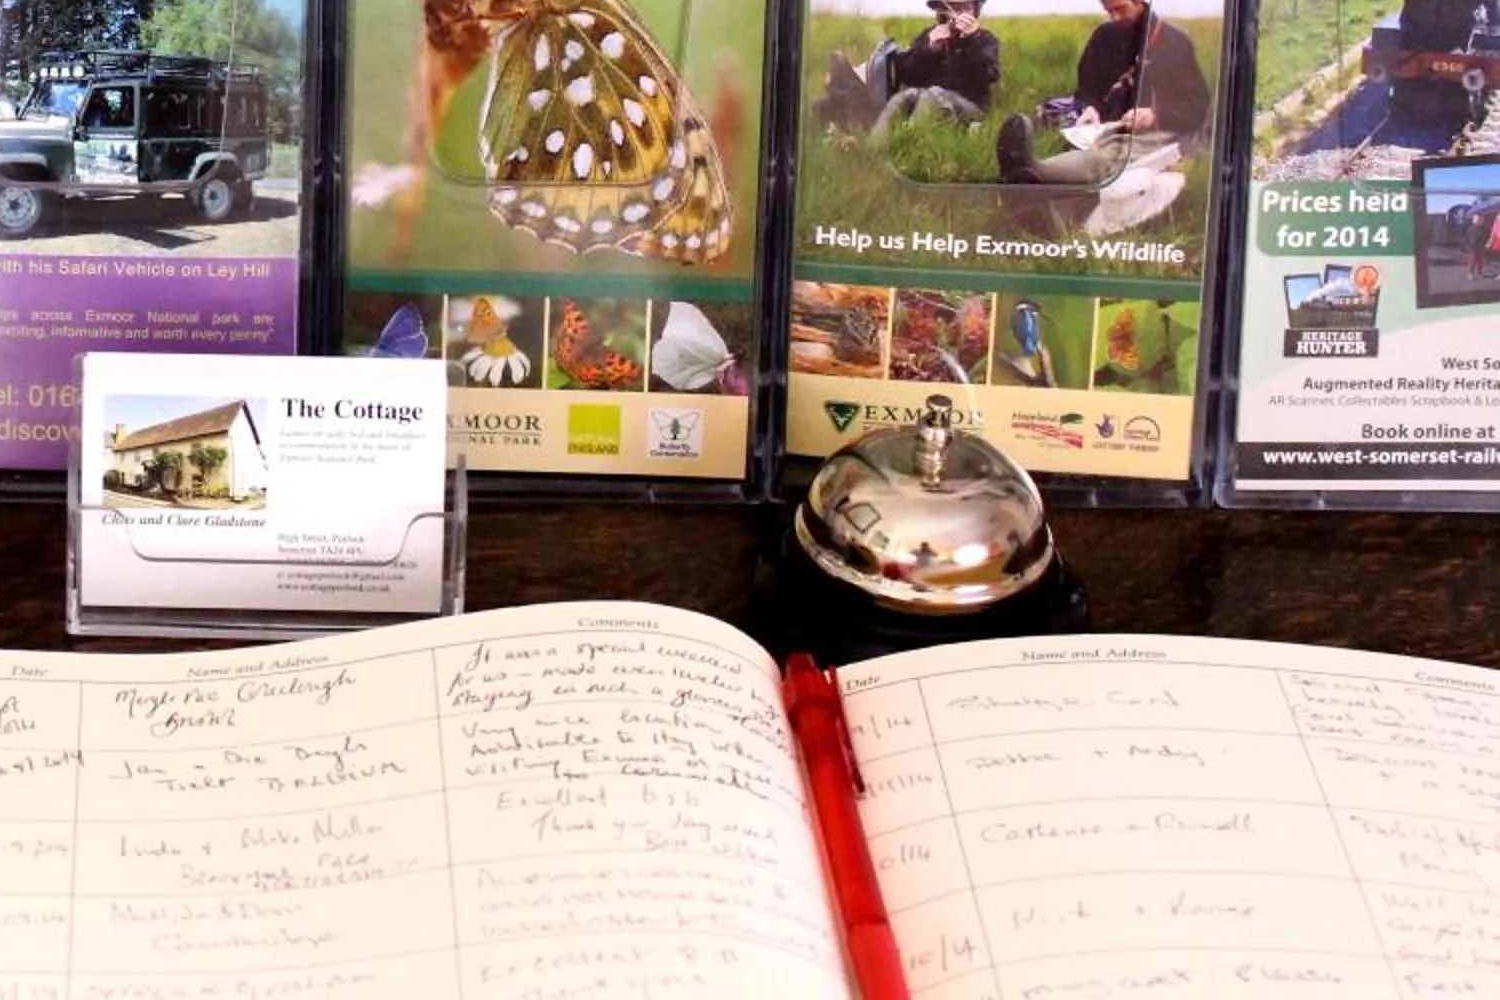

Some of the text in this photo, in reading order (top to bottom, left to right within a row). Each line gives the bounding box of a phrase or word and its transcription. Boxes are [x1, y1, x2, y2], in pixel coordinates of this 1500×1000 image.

[1263, 190, 1407, 213] Prices held
[1277, 227, 1390, 247] for 2014
[815, 226, 1185, 264] Help us Help Exmoor's Wildlife
[29, 258, 53, 274] his
[58, 259, 107, 275] Safari
[113, 260, 175, 277] Vehicle
[181, 266, 201, 277] on
[243, 263, 271, 277] Hill
[1302, 332, 1363, 341] HERITAGE
[1296, 342, 1367, 355] HUNTER
[1442, 357, 1478, 370] West
[281, 398, 423, 423] The Cottage
[1361, 424, 1495, 439] Book online at
[578, 618, 660, 629] Comments
[1022, 648, 1166, 660] Name and Address
[12, 667, 47, 677] Date
[187, 656, 329, 677] Name and Address
[846, 675, 880, 689] Date
[1413, 671, 1493, 687] Comments
